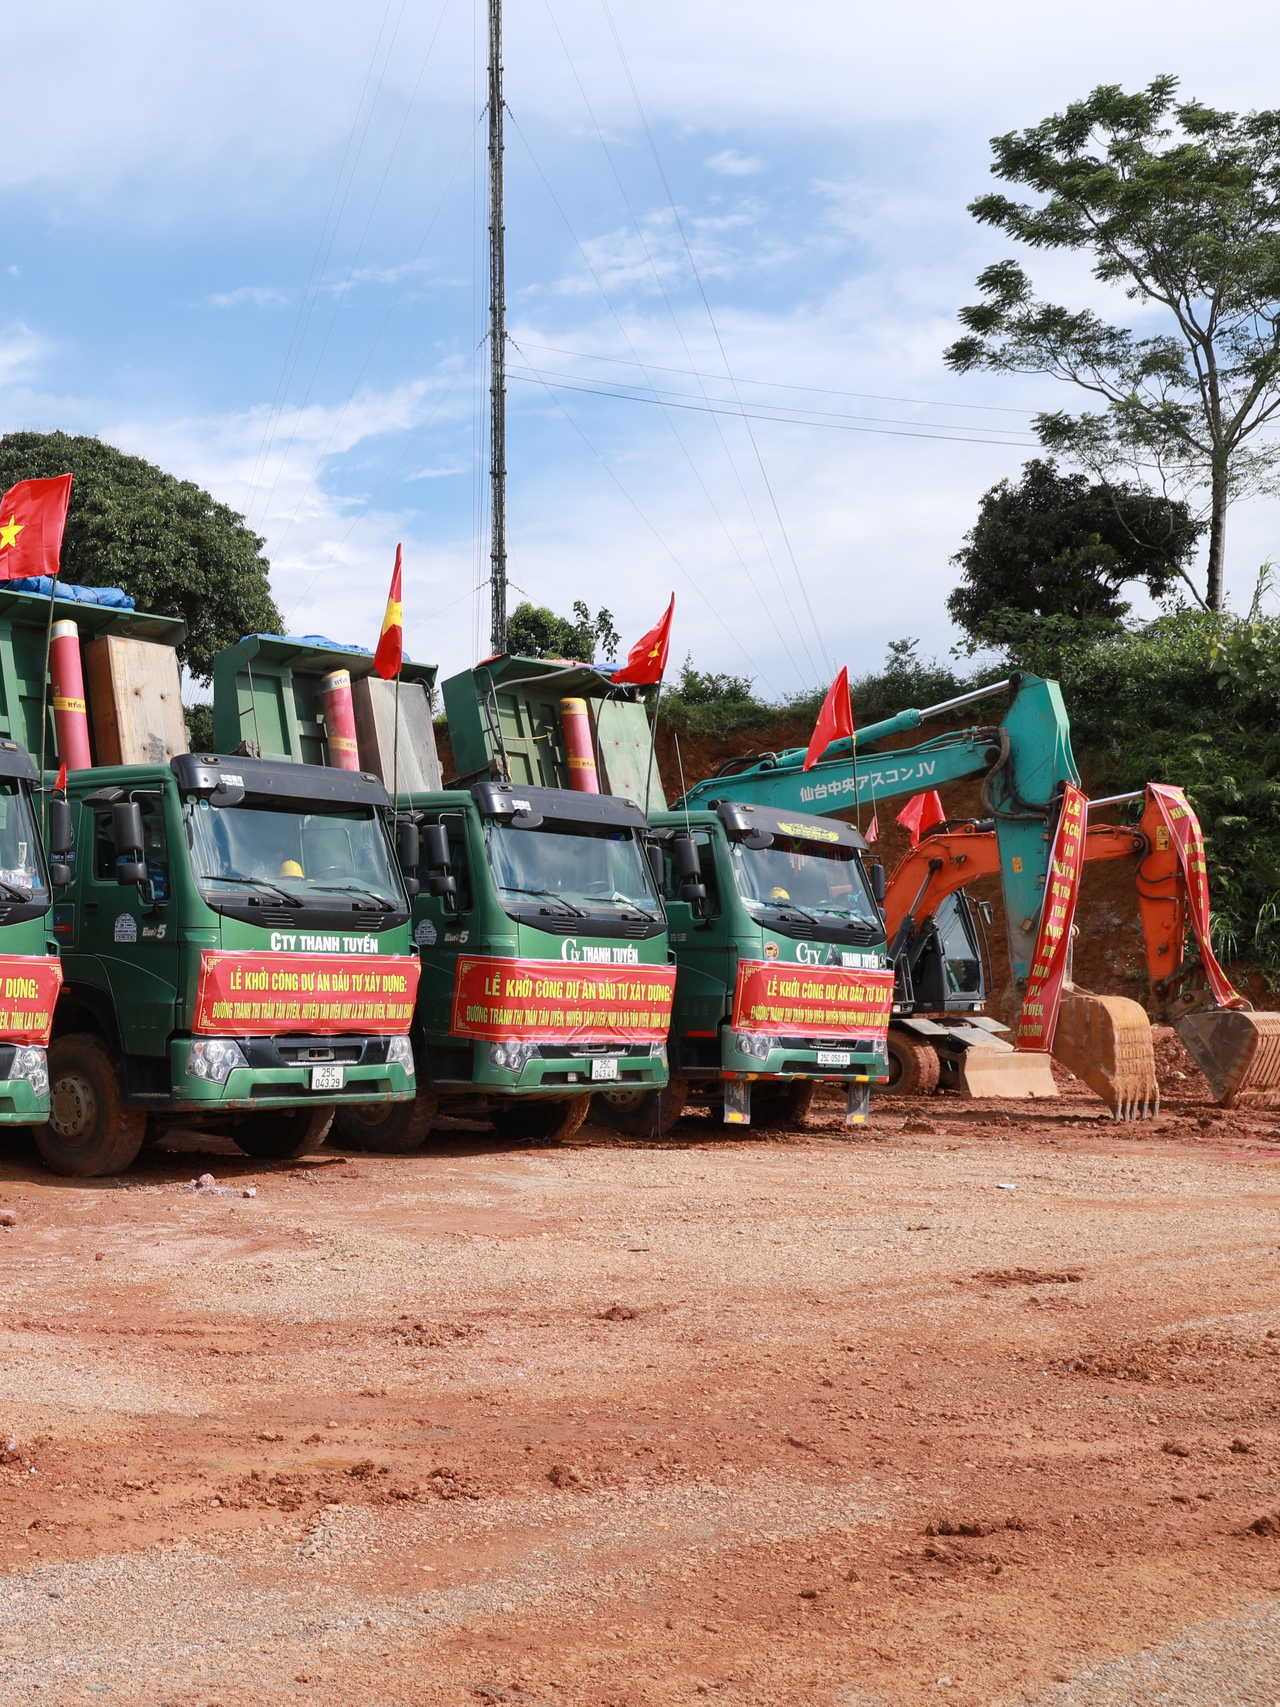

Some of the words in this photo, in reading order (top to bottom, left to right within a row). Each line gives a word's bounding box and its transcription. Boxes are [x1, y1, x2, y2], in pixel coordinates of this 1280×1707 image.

[270, 932, 296, 951] CTY
[300, 935, 339, 952] THANH
[343, 933, 378, 953] TUYỀN
[582, 946, 611, 962] THANH
[796, 942, 821, 965] CTY
[841, 952, 862, 968] THANH
[5, 976, 39, 1003] DỰNG:
[230, 965, 242, 990] LỄ
[245, 966, 269, 991] KHỞI
[272, 969, 299, 991] CÔNG
[301, 972, 315, 995] DỰ
[317, 969, 331, 992] ÁN
[332, 968, 350, 992] ĐẦU
[352, 973, 364, 992] TƯ
[364, 971, 381, 992] XÂY
[382, 974, 407, 996] DỰNG:
[485, 971, 501, 996] LỄ
[506, 974, 533, 998] KHỞI
[535, 977, 563, 999] CÔNG
[565, 980, 580, 1003] DỰ
[582, 978, 596, 1000] ÁN
[599, 977, 616, 1000] ĐẦU
[618, 982, 629, 1001] TƯ
[630, 980, 646, 1001] XÂY
[780, 976, 800, 998] KHỞI
[802, 980, 824, 1000] CÔNG
[825, 984, 837, 1004] DỰ
[838, 982, 849, 1001] ÁN
[875, 985, 888, 1003] XÂY
[212, 998, 234, 1019] ĐƯỜNG
[234, 999, 251, 1019] TRÁNH
[466, 1003, 488, 1023] ĐƯỜNG
[490, 1005, 513, 1026] TRÁNH
[24, 1012, 33, 1030] LAI
[322, 1068, 335, 1078] 25C
[595, 1070, 614, 1079] 043.41
[600, 1060, 611, 1069] 25C
[315, 1078, 340, 1088] 043.29
